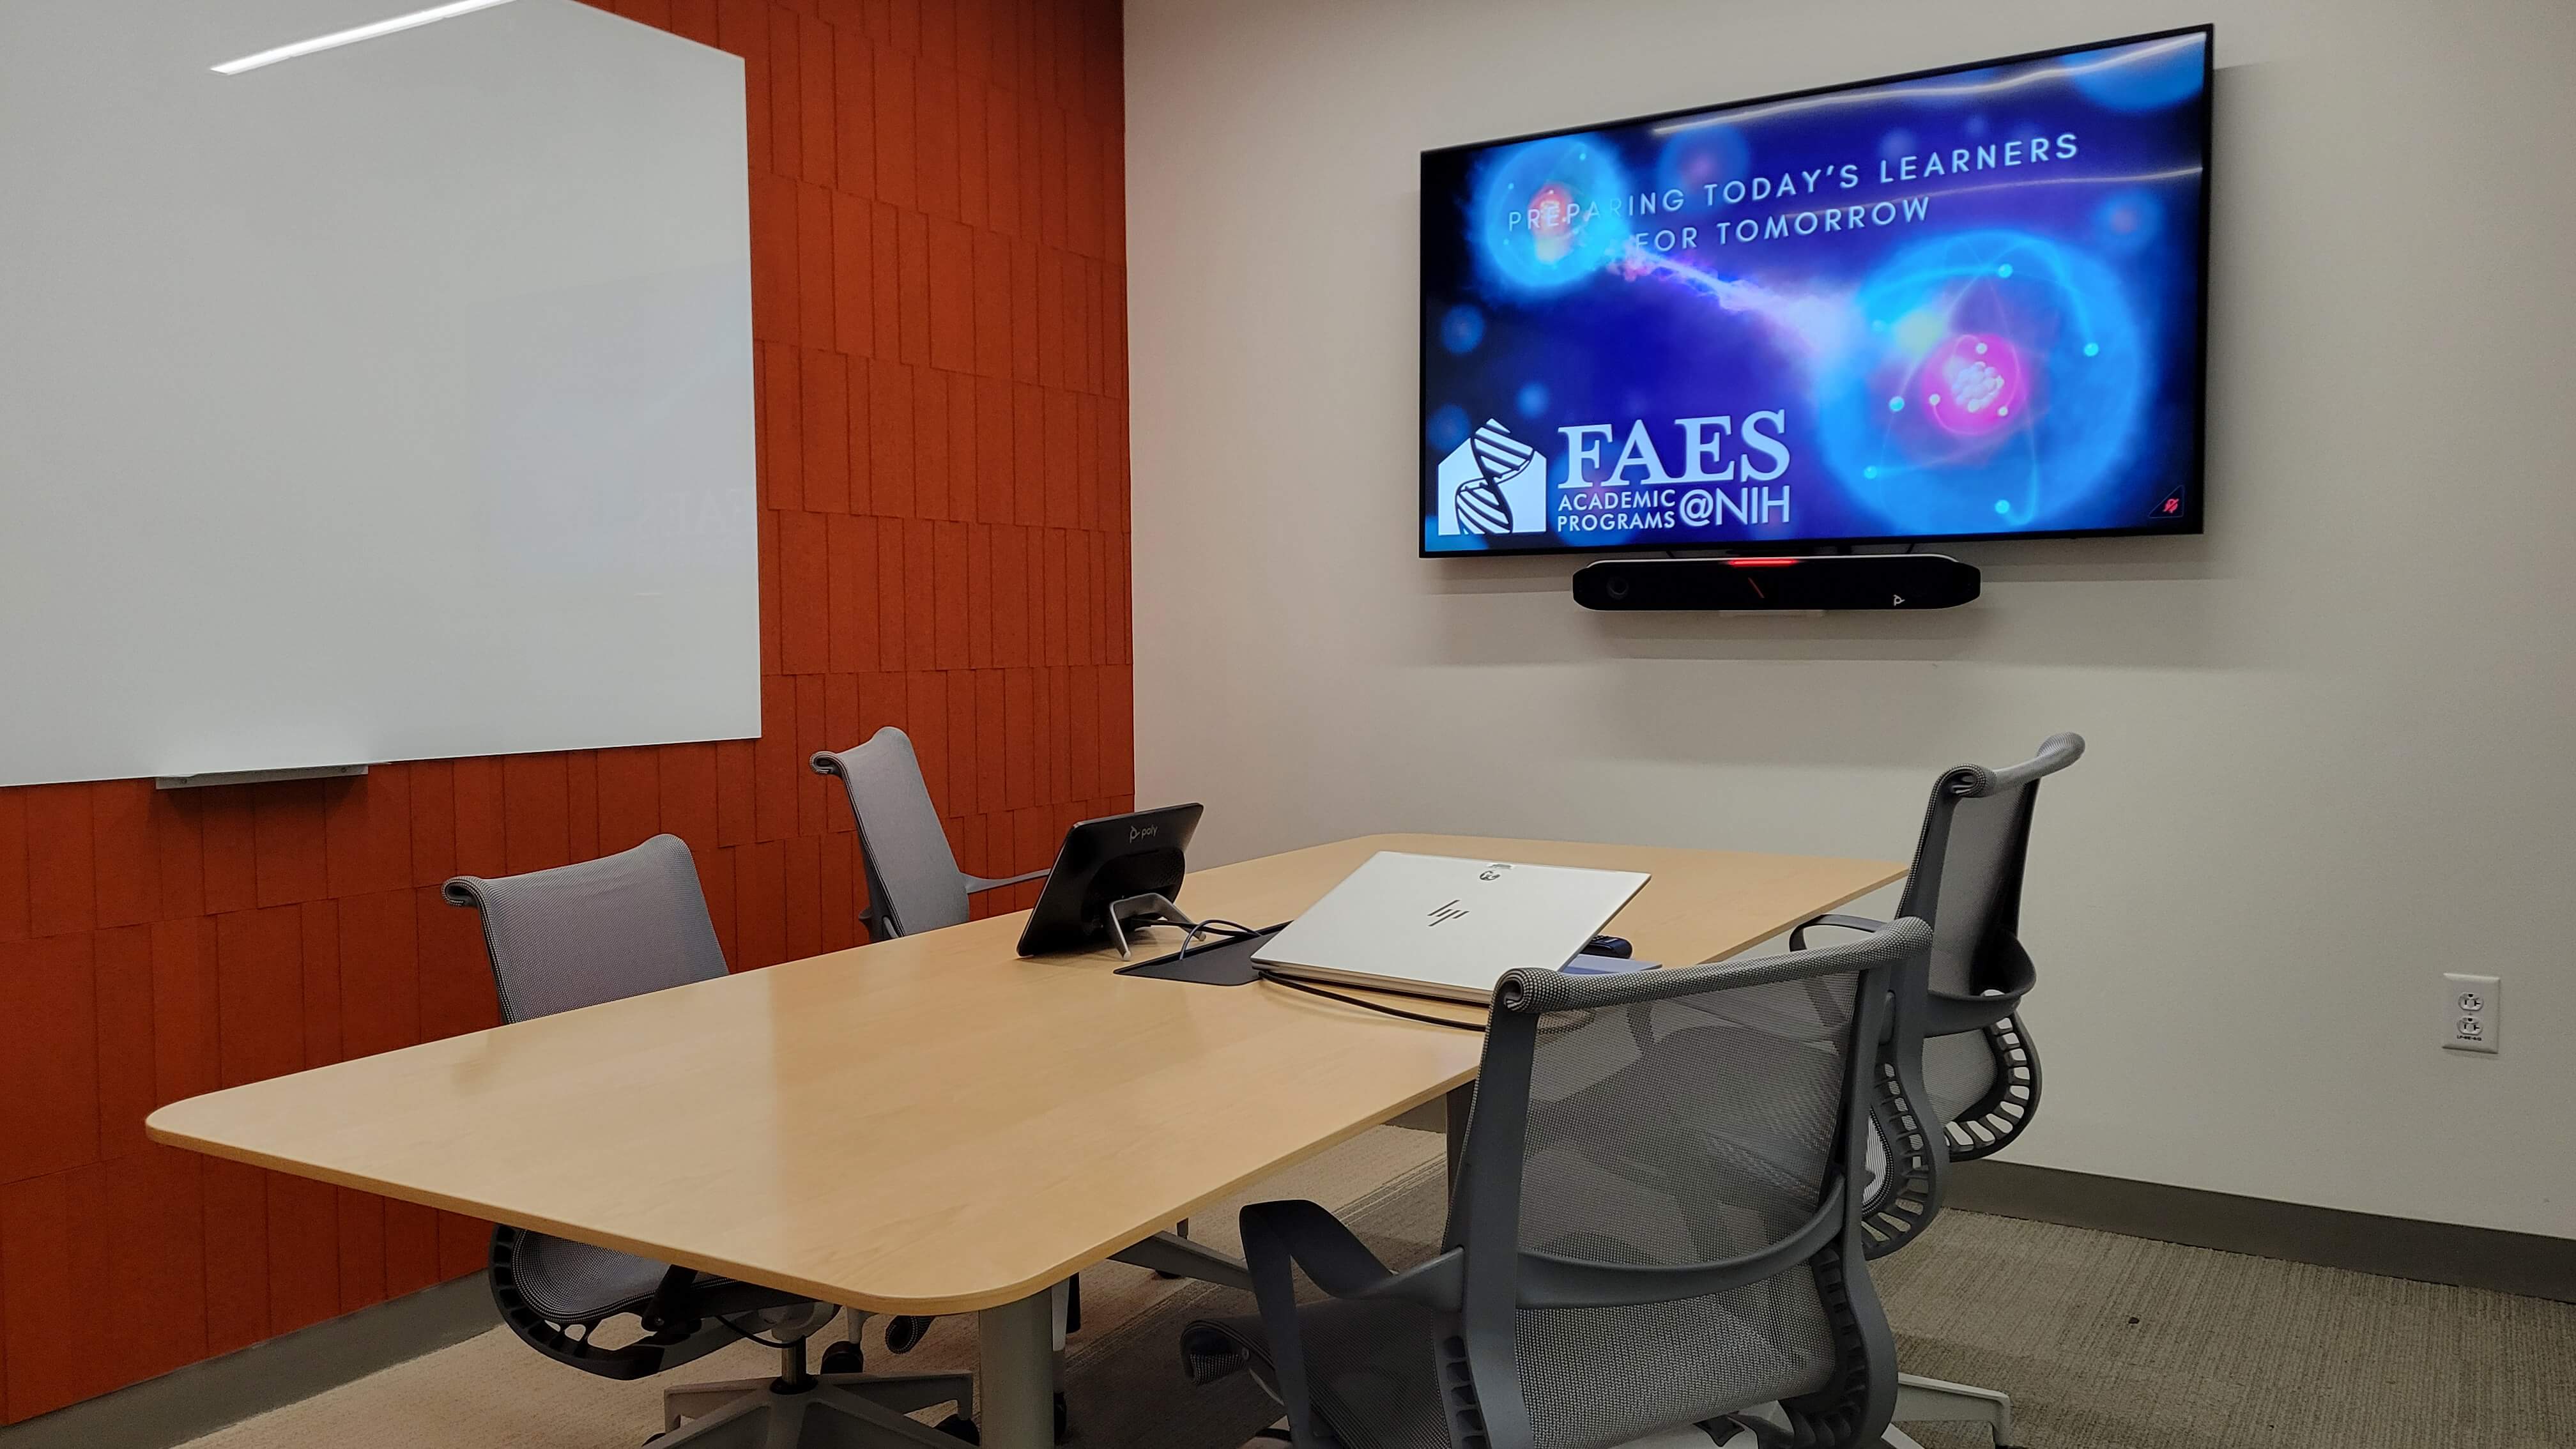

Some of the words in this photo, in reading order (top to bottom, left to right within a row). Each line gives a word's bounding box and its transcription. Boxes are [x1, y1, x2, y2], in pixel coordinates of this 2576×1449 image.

[1508, 188, 1685, 232] PREPARING
[1704, 164, 1859, 207] TODAY'S
[1880, 133, 2078, 183] LEARNERS
[1636, 226, 1698, 252] FOR
[1717, 196, 1929, 245] TOMORROW
[1558, 409, 1790, 489] FAES
[1558, 489, 1675, 511] ACADEMIC
[1680, 485, 1790, 526] @NIH
[1558, 510, 1675, 532] PROGRAMS
[1142, 824, 1158, 839] poly
